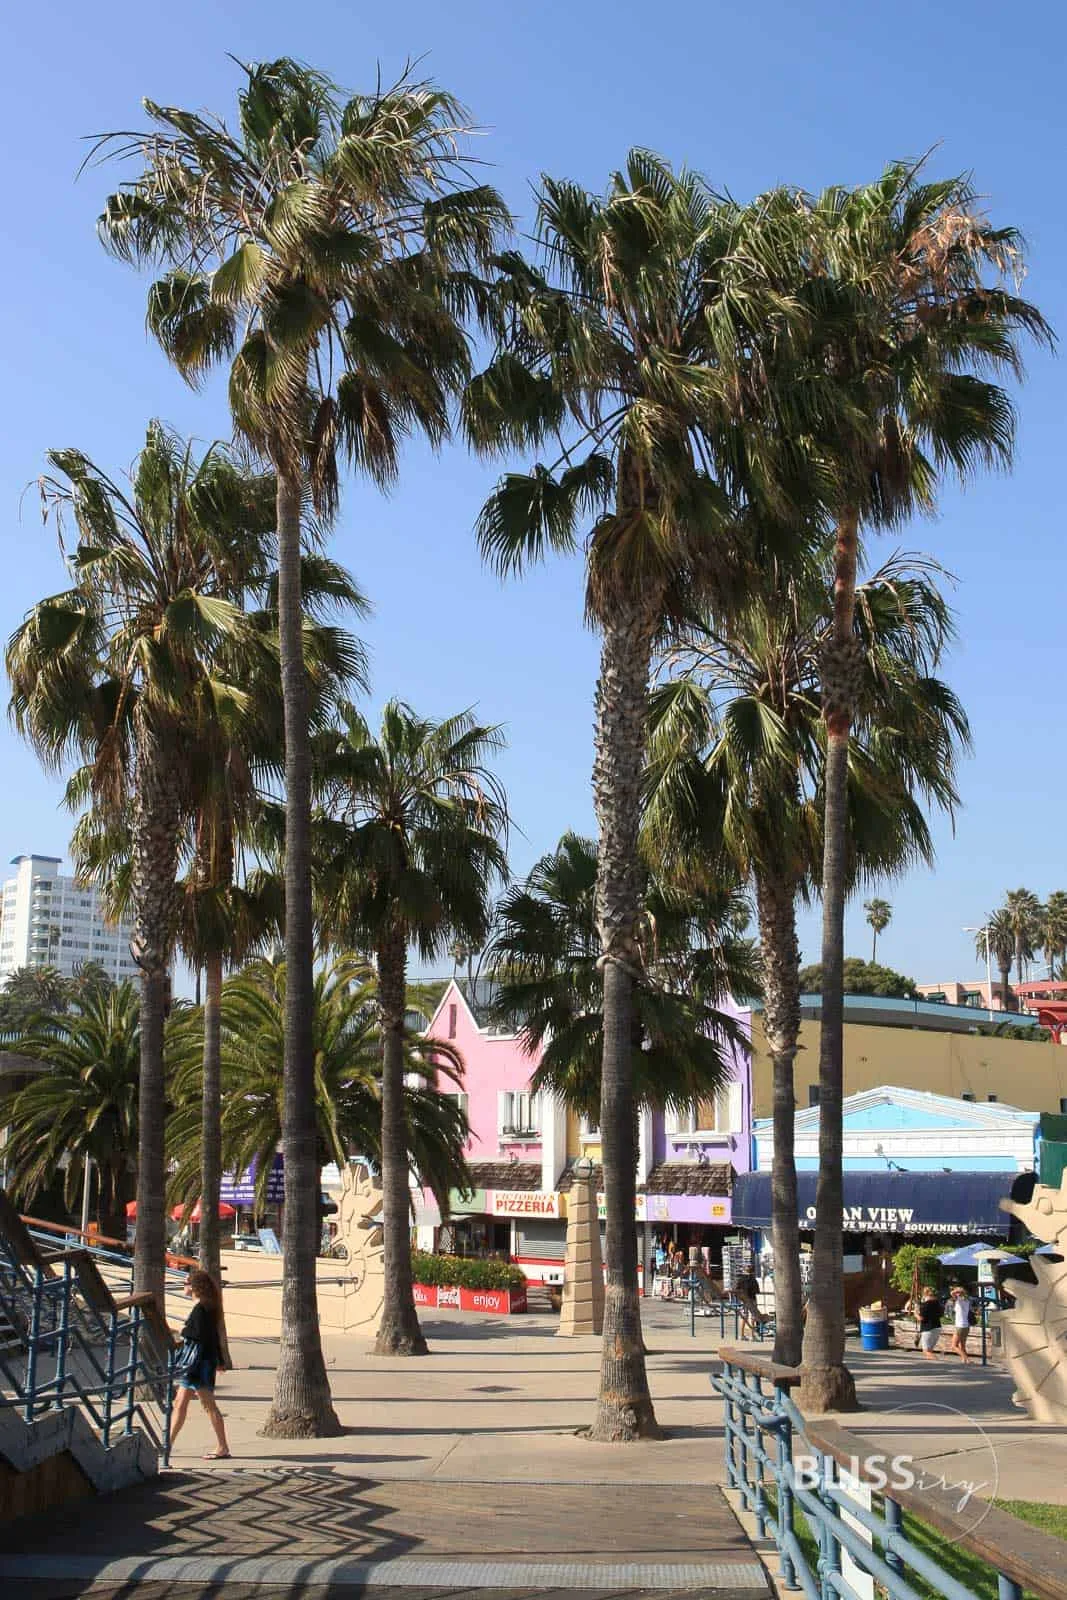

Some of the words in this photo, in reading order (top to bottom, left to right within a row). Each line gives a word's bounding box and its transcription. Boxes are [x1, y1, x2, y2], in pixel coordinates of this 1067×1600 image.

[496, 1200, 554, 1213] PIZZERIA
[806, 1207, 862, 1220] OAN
[868, 1208, 914, 1222] VIEW
[904, 1223, 968, 1233] SOUVENIR'S
[473, 1295, 500, 1309] enjoy
